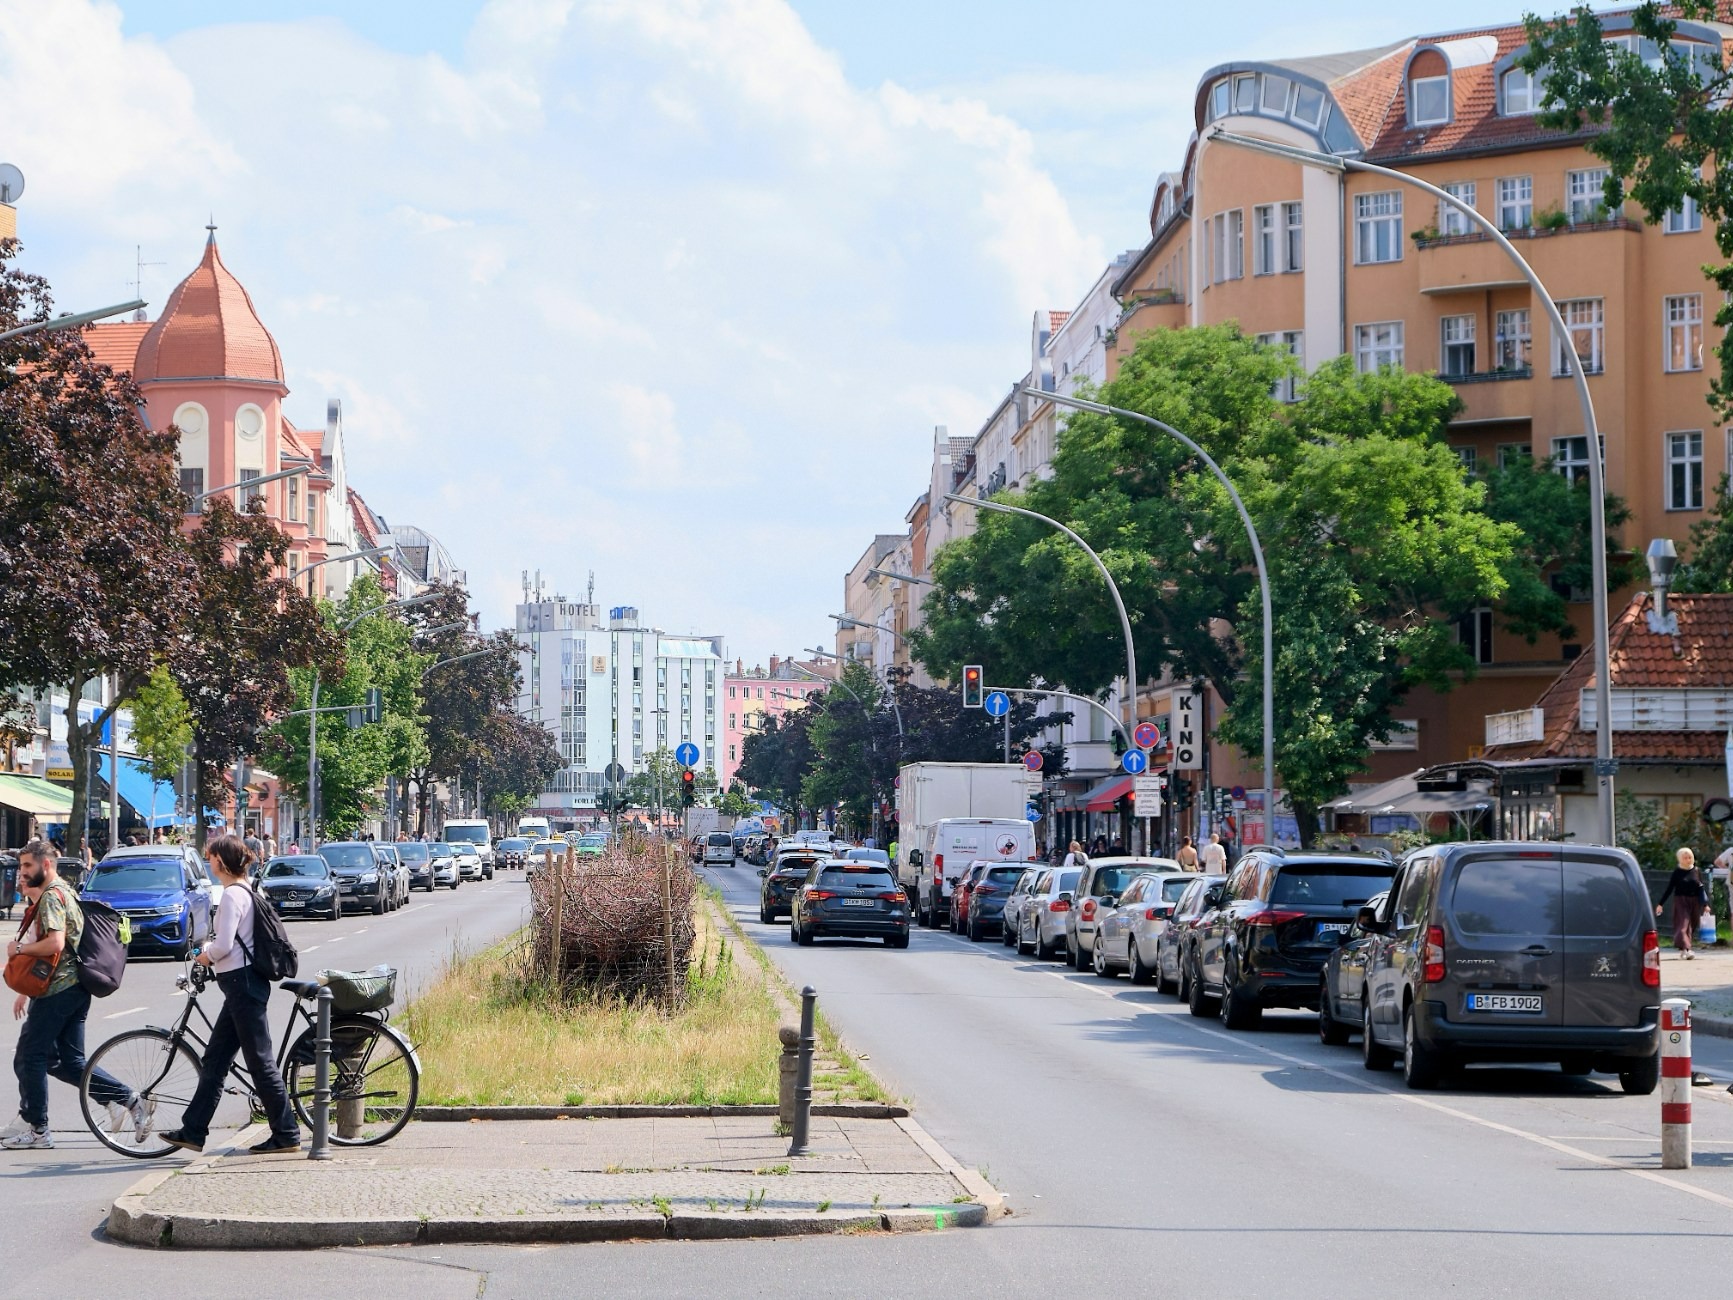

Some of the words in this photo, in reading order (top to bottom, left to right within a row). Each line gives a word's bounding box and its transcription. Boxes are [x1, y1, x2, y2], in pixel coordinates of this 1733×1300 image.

[559, 603, 596, 617] HOTEL
[1179, 696, 1194, 763] KINO
[1476, 996, 1484, 1008] B
[1491, 996, 1507, 1008] FB
[1510, 997, 1540, 1009] 1902
